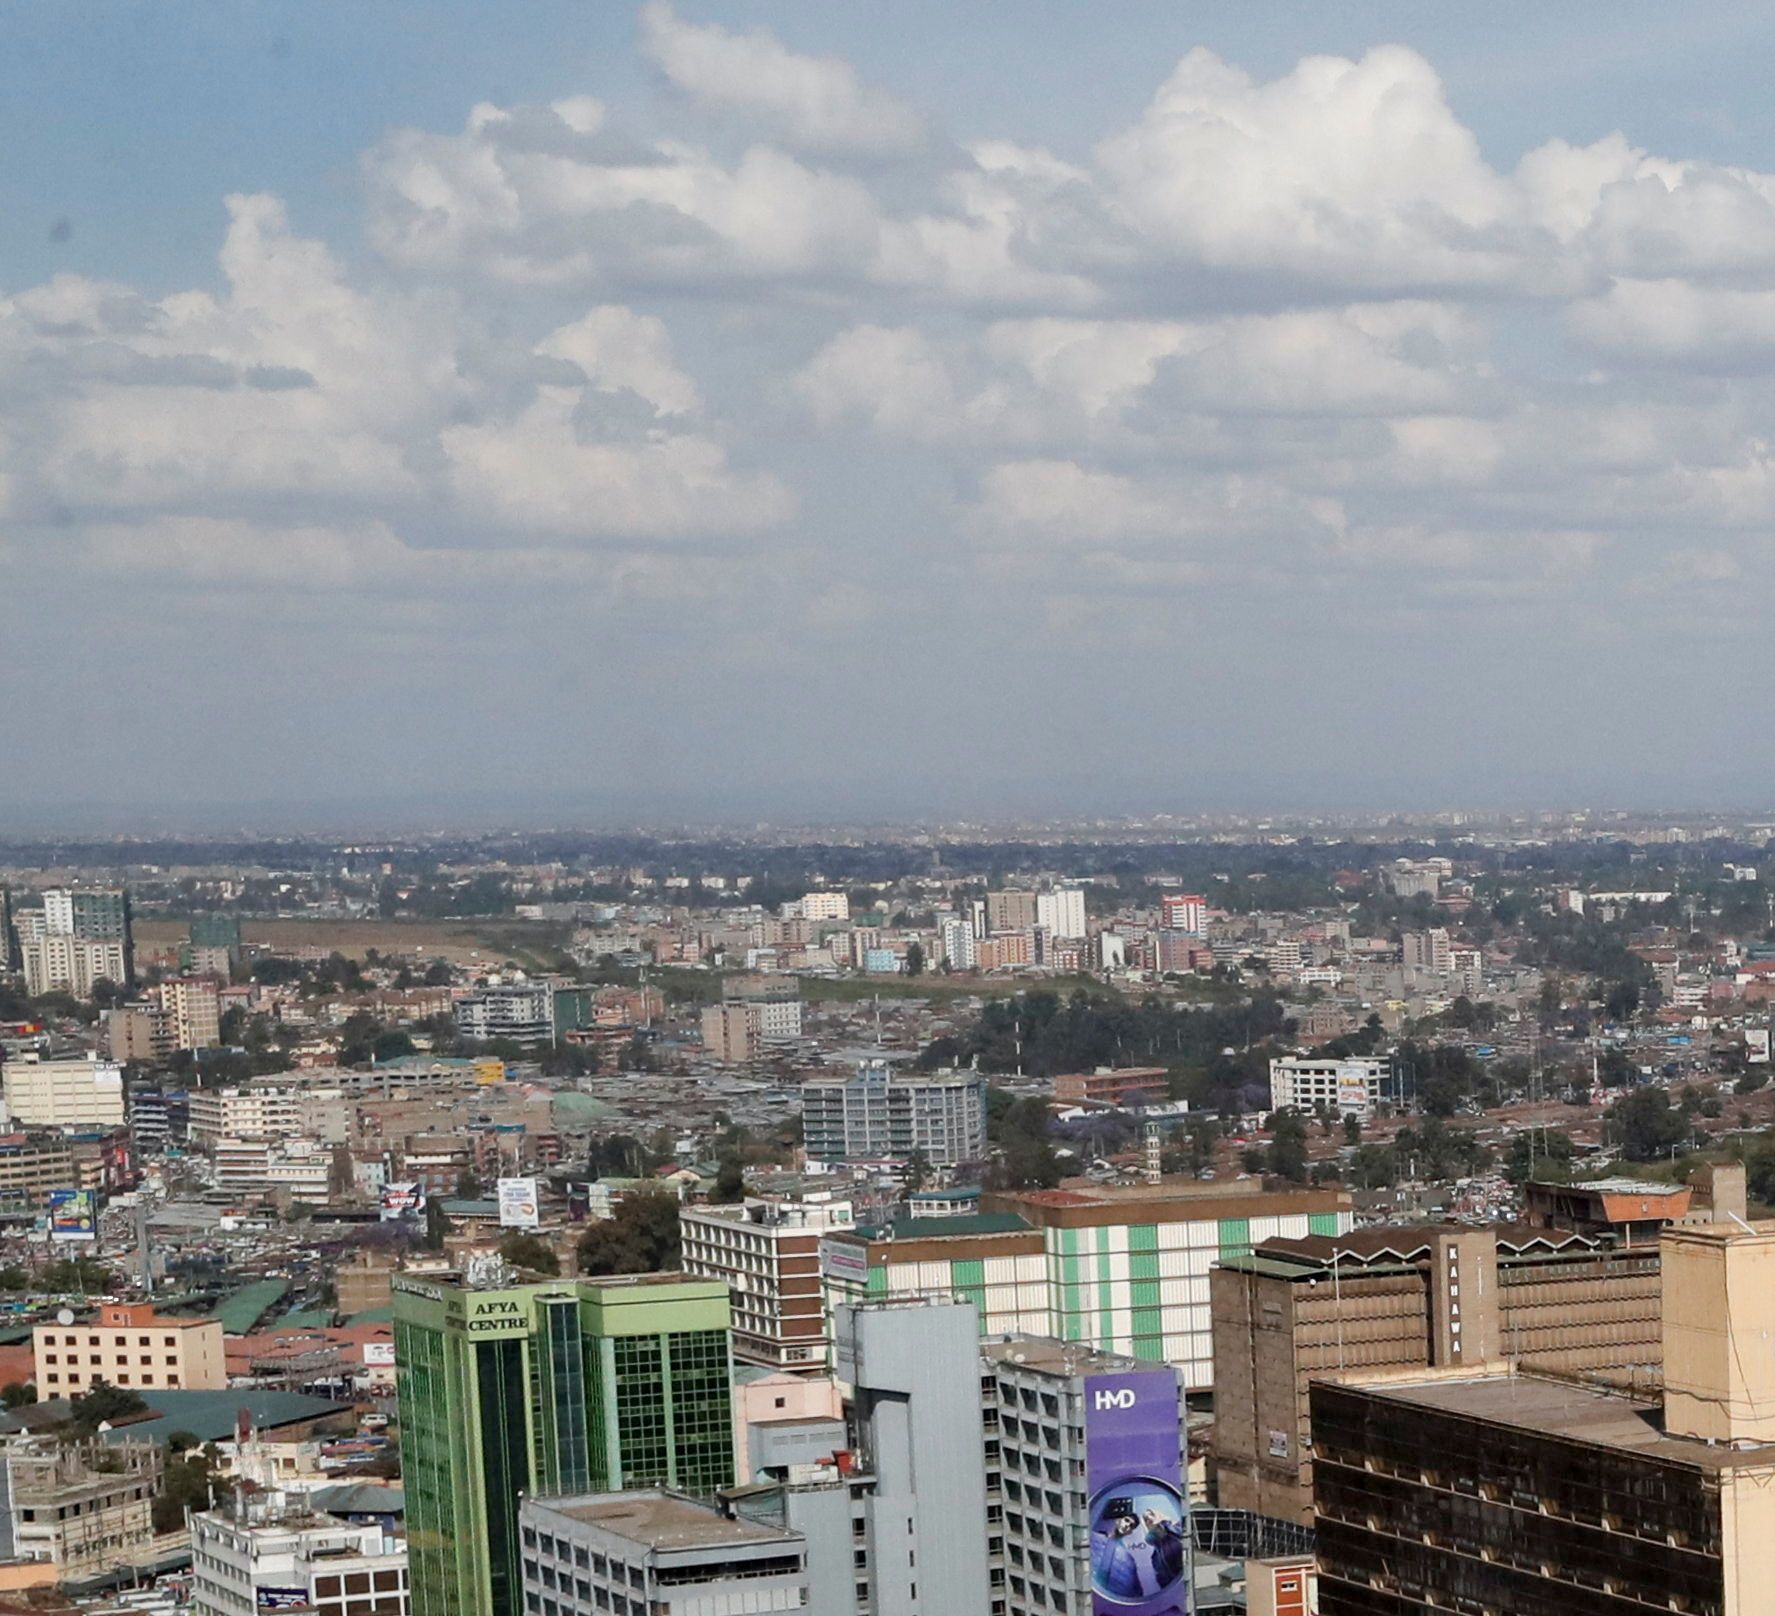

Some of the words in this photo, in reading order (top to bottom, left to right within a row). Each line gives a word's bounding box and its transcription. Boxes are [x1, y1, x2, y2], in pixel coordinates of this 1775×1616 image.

[475, 1301, 519, 1315] AFYA
[1449, 1247, 1461, 1353] KAHAWA
[468, 1317, 528, 1332] CENTRE
[1094, 1388, 1136, 1410] HMD
